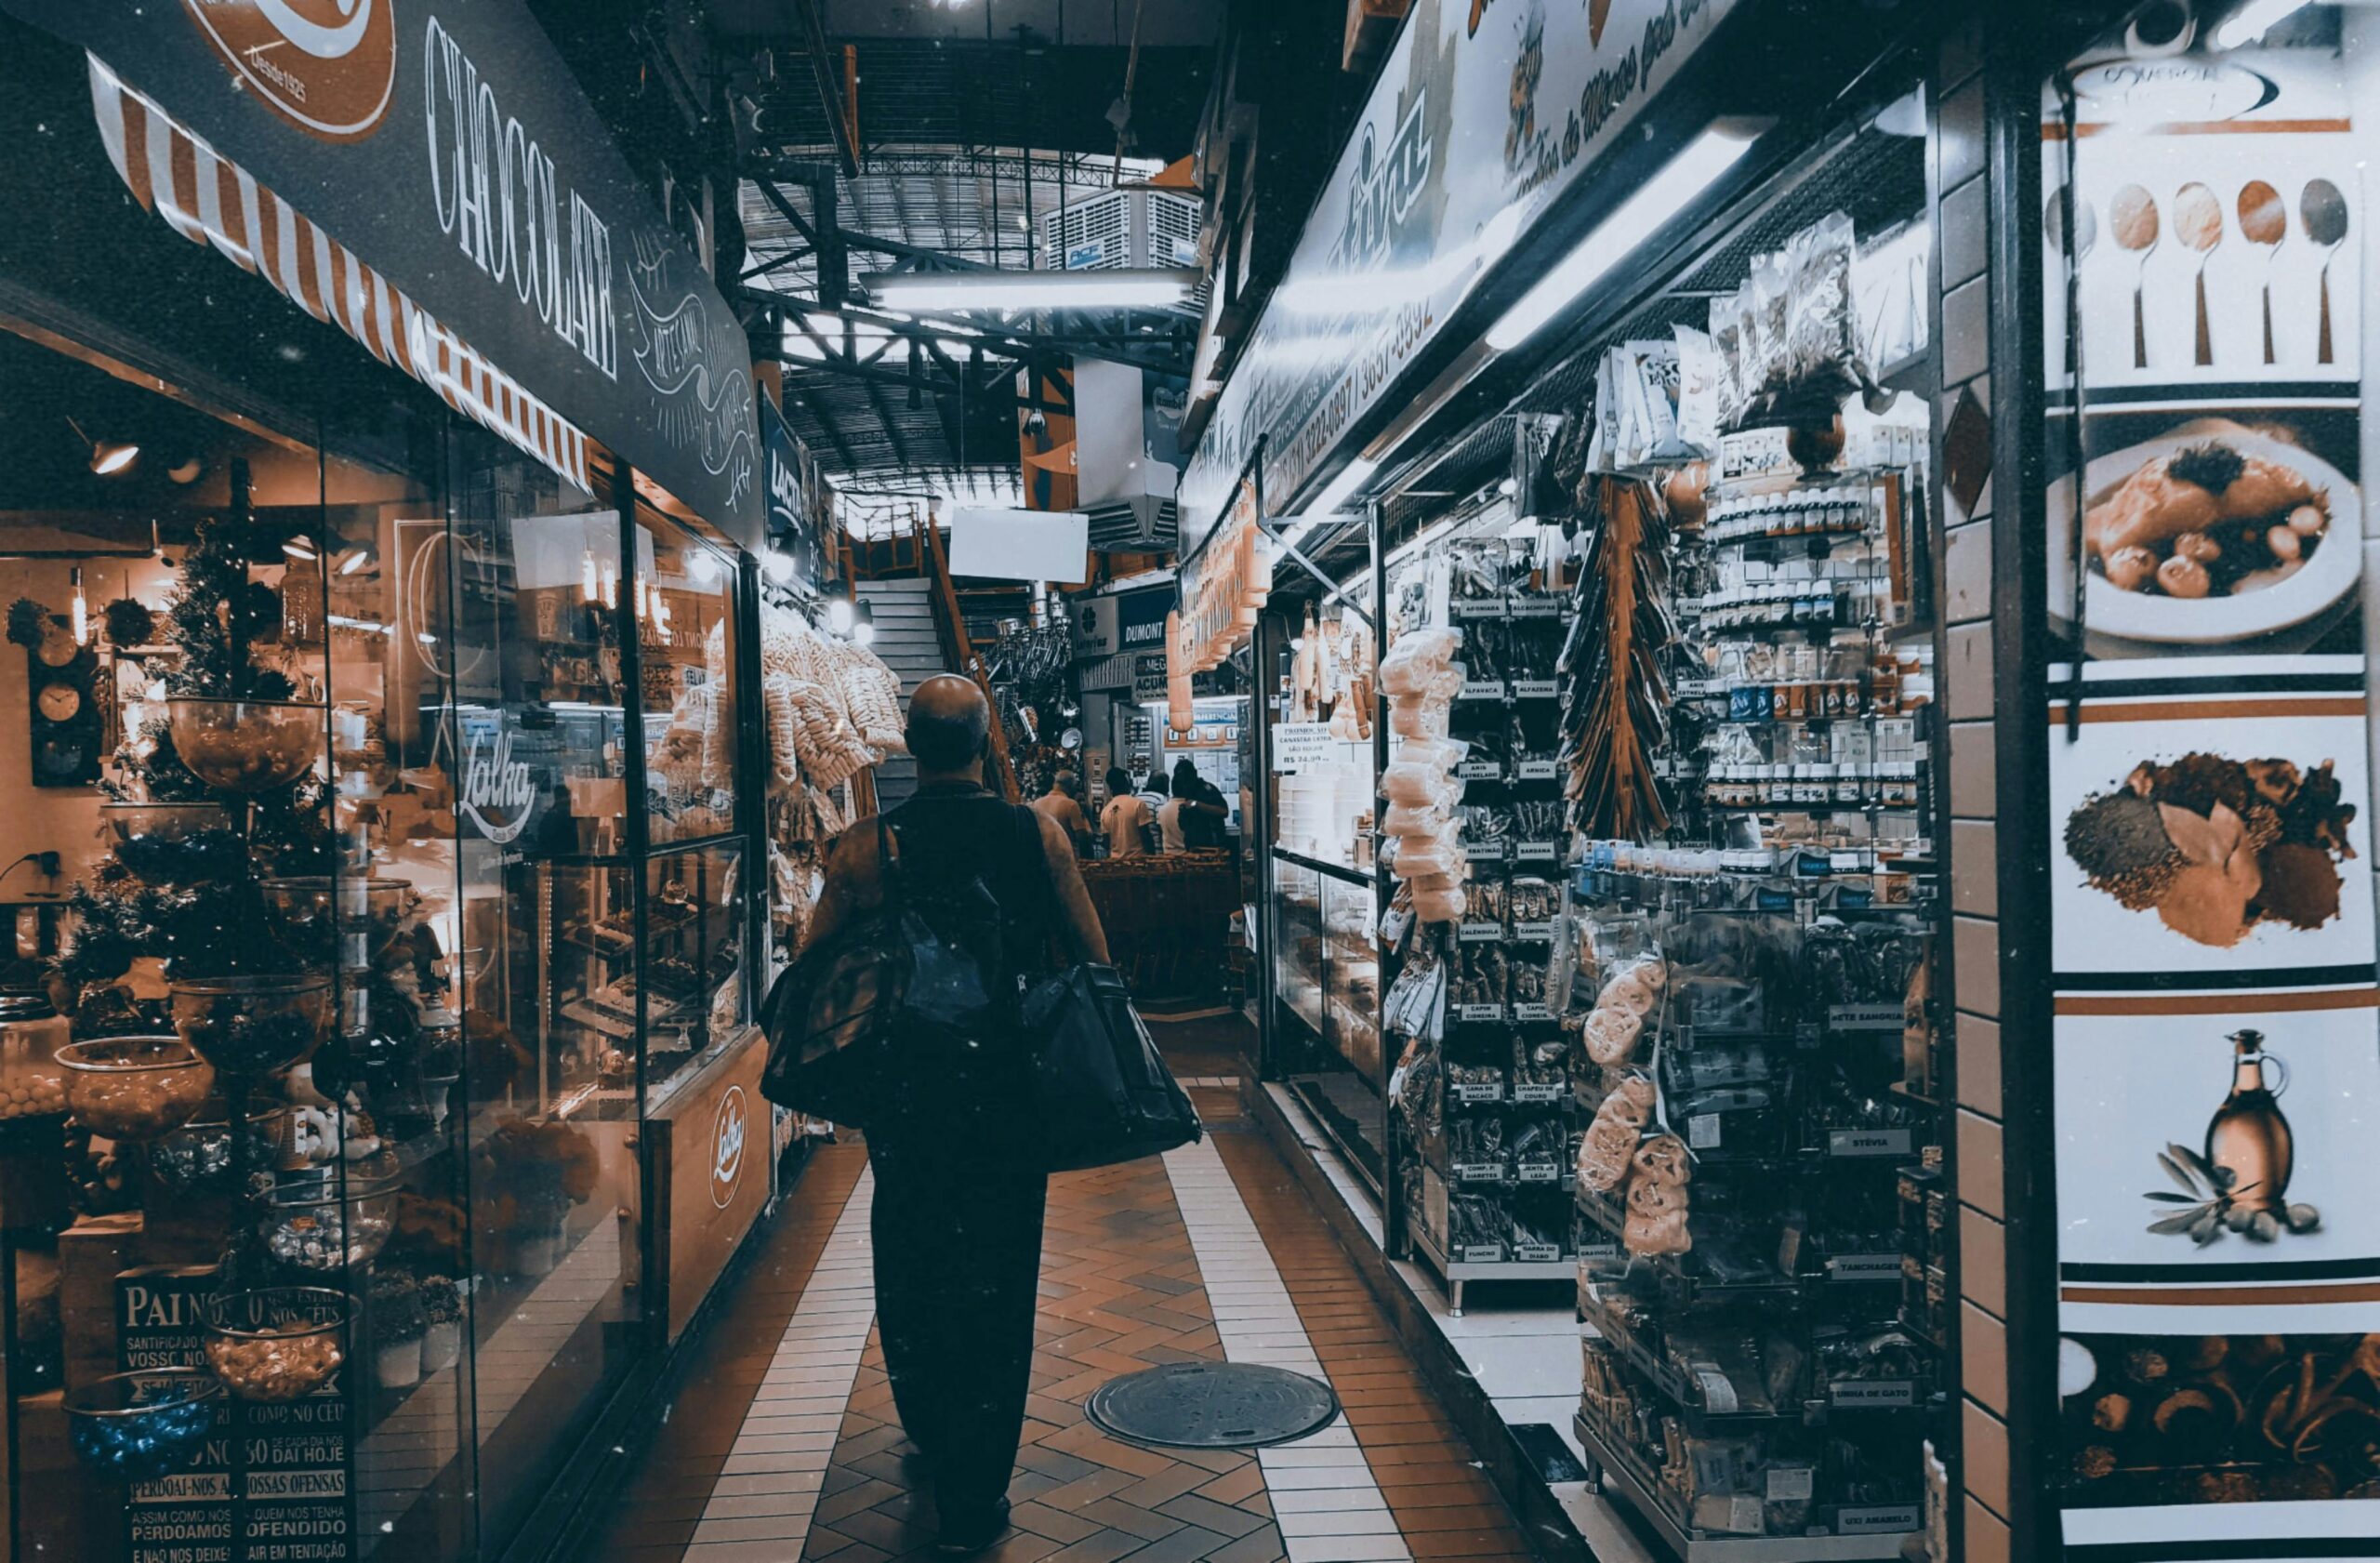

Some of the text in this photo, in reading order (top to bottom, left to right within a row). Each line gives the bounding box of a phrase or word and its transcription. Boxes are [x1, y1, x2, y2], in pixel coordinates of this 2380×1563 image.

[425, 15, 616, 382] CHOCOLATE
[1305, 374, 1353, 464] 3222-0897
[1361, 296, 1433, 400] 3657-0892
[1276, 376, 1320, 452] Produtos
[772, 447, 803, 523] LACTA
[1125, 621, 1164, 642] DUMONT
[1146, 656, 1167, 672] MEG
[455, 727, 535, 820] Lalka
[1831, 1013, 1904, 1021] SETE SANGRIA
[1852, 1137, 1888, 1146] STÉVIA
[125, 1286, 182, 1327] PAI
[1866, 1389, 1879, 1397] DE
[1881, 1389, 1910, 1397] GATO
[293, 1404, 313, 1423] NO
[317, 1400, 346, 1423] CÉU
[272, 1446, 345, 1464] DAI HOJE
[246, 1475, 288, 1494] OSSAS
[290, 1473, 345, 1493] OFENSAS
[131, 1511, 166, 1525] ASSIM
[169, 1509, 205, 1523] COMO
[254, 1504, 345, 1521] QUEM NOS TENHA
[1865, 1515, 1912, 1524] AMARELO
[132, 1524, 231, 1542] PERDOAMOS
[245, 1520, 348, 1538] OFENDIDO
[169, 1547, 192, 1563] NOS
[248, 1540, 347, 1563] AIR EM TENTAÇÃO
